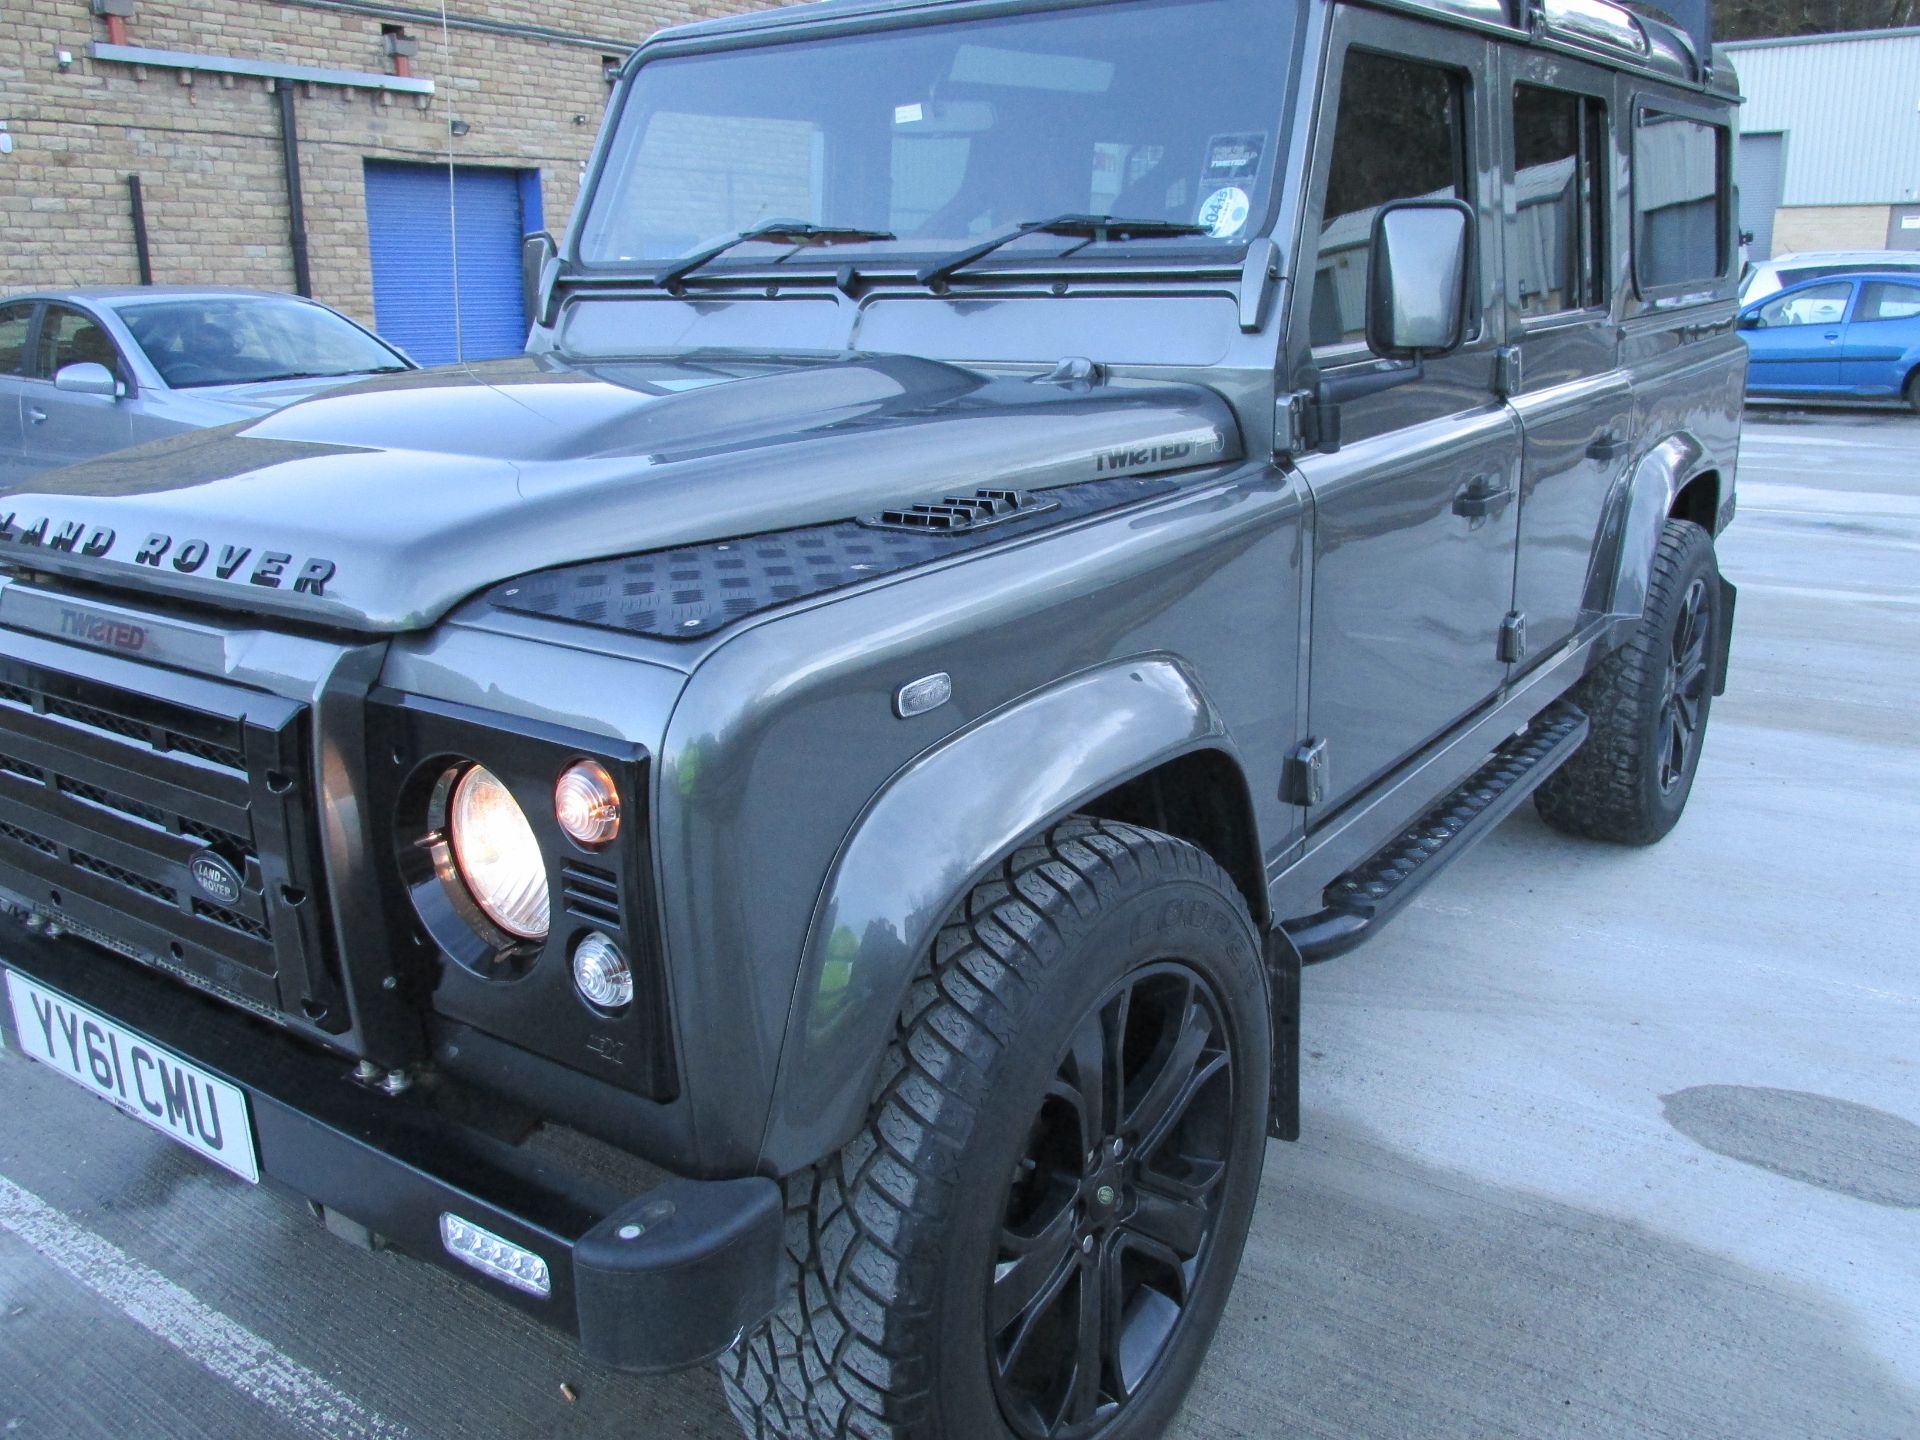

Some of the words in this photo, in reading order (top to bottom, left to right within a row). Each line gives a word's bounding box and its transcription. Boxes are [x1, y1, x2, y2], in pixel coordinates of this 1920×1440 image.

[1095, 440, 1191, 472] TWISTED
[0, 511, 116, 558] LAND
[135, 531, 336, 596] ROVER
[60, 608, 145, 651] TWISTED
[198, 863, 221, 882] LAND
[202, 877, 231, 896] ROVER
[30, 990, 127, 1099] YY61
[130, 1045, 224, 1151] CMU
